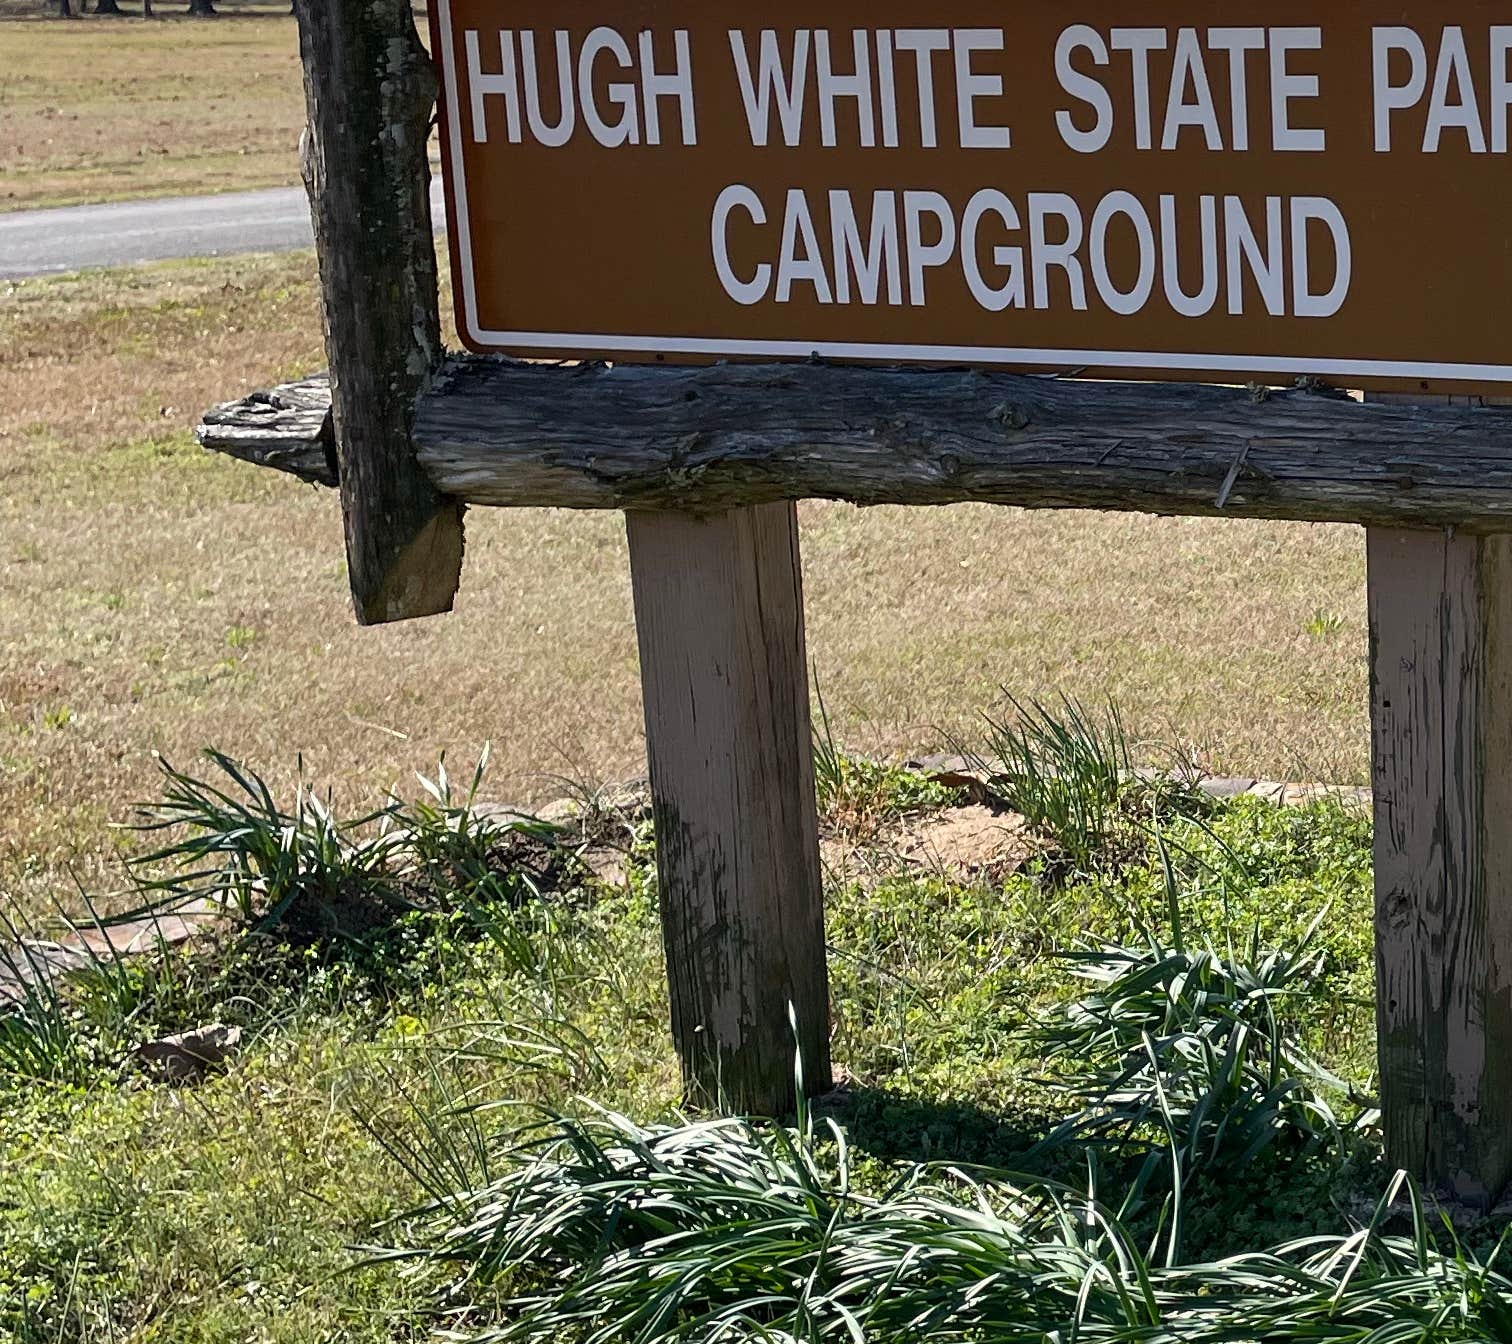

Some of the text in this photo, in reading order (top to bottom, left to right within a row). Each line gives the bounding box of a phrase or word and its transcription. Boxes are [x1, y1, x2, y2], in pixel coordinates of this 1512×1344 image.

[464, 26, 698, 148] HUGH
[728, 28, 1012, 149] WHITE
[1053, 24, 1326, 153] STATE
[710, 184, 1352, 317] CAMPGROUND
